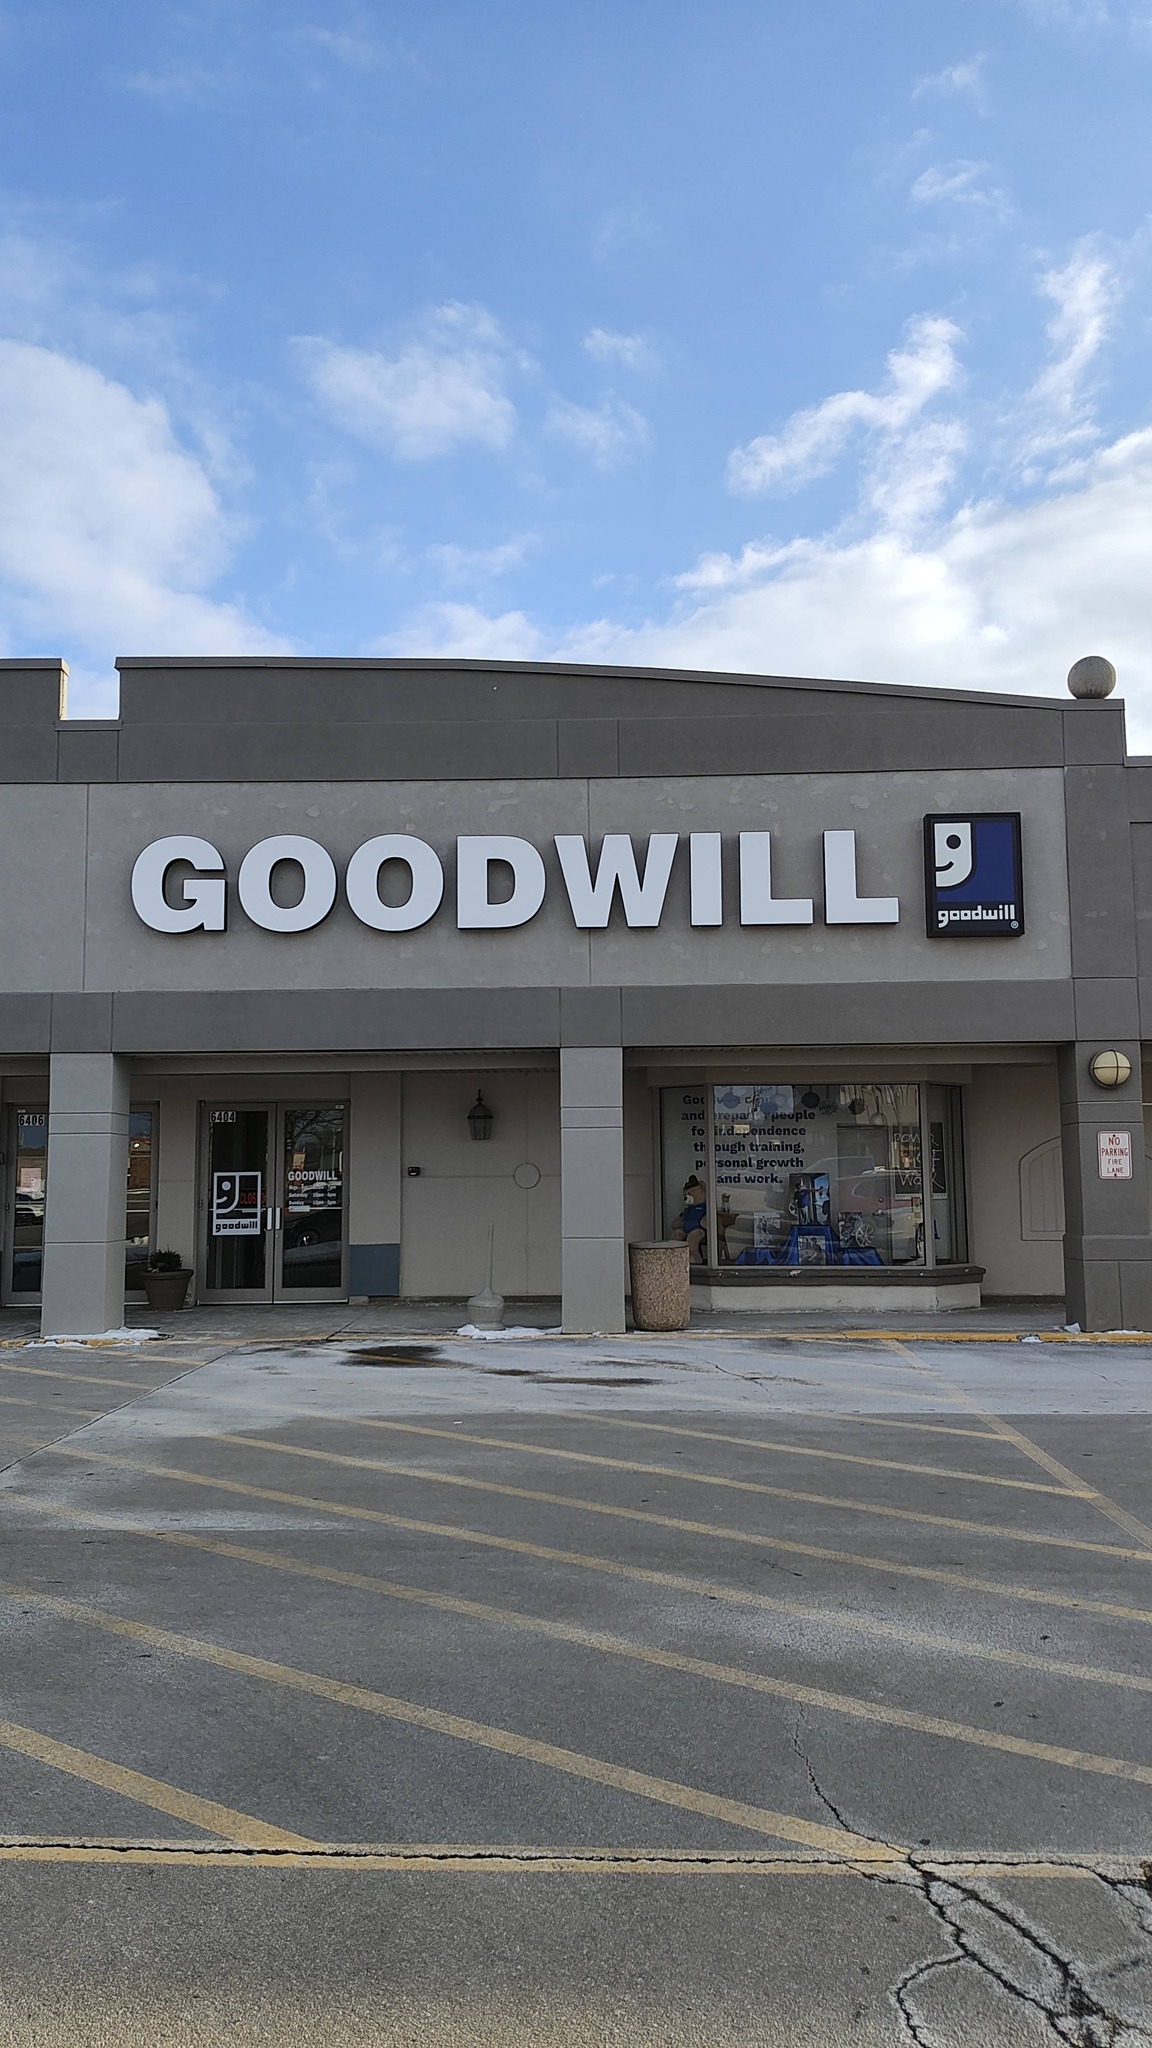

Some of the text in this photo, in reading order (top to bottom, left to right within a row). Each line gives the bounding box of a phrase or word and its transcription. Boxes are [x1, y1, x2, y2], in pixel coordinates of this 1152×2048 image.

[131, 830, 900, 933] GOODWILL
[938, 904, 1015, 928] goodwill
[19, 1115, 44, 1125] 6406
[211, 1112, 235, 1122] 6404
[681, 1110, 704, 1120] and
[1109, 1137, 1120, 1145] NO
[693, 1141, 805, 1154] though training,
[1102, 1148, 1128, 1156] PARKING
[756, 1157, 804, 1170] growth
[288, 1171, 338, 1181] GOODWILL
[717, 1173, 783, 1184] and work.
[215, 1221, 258, 1232] goodwill
